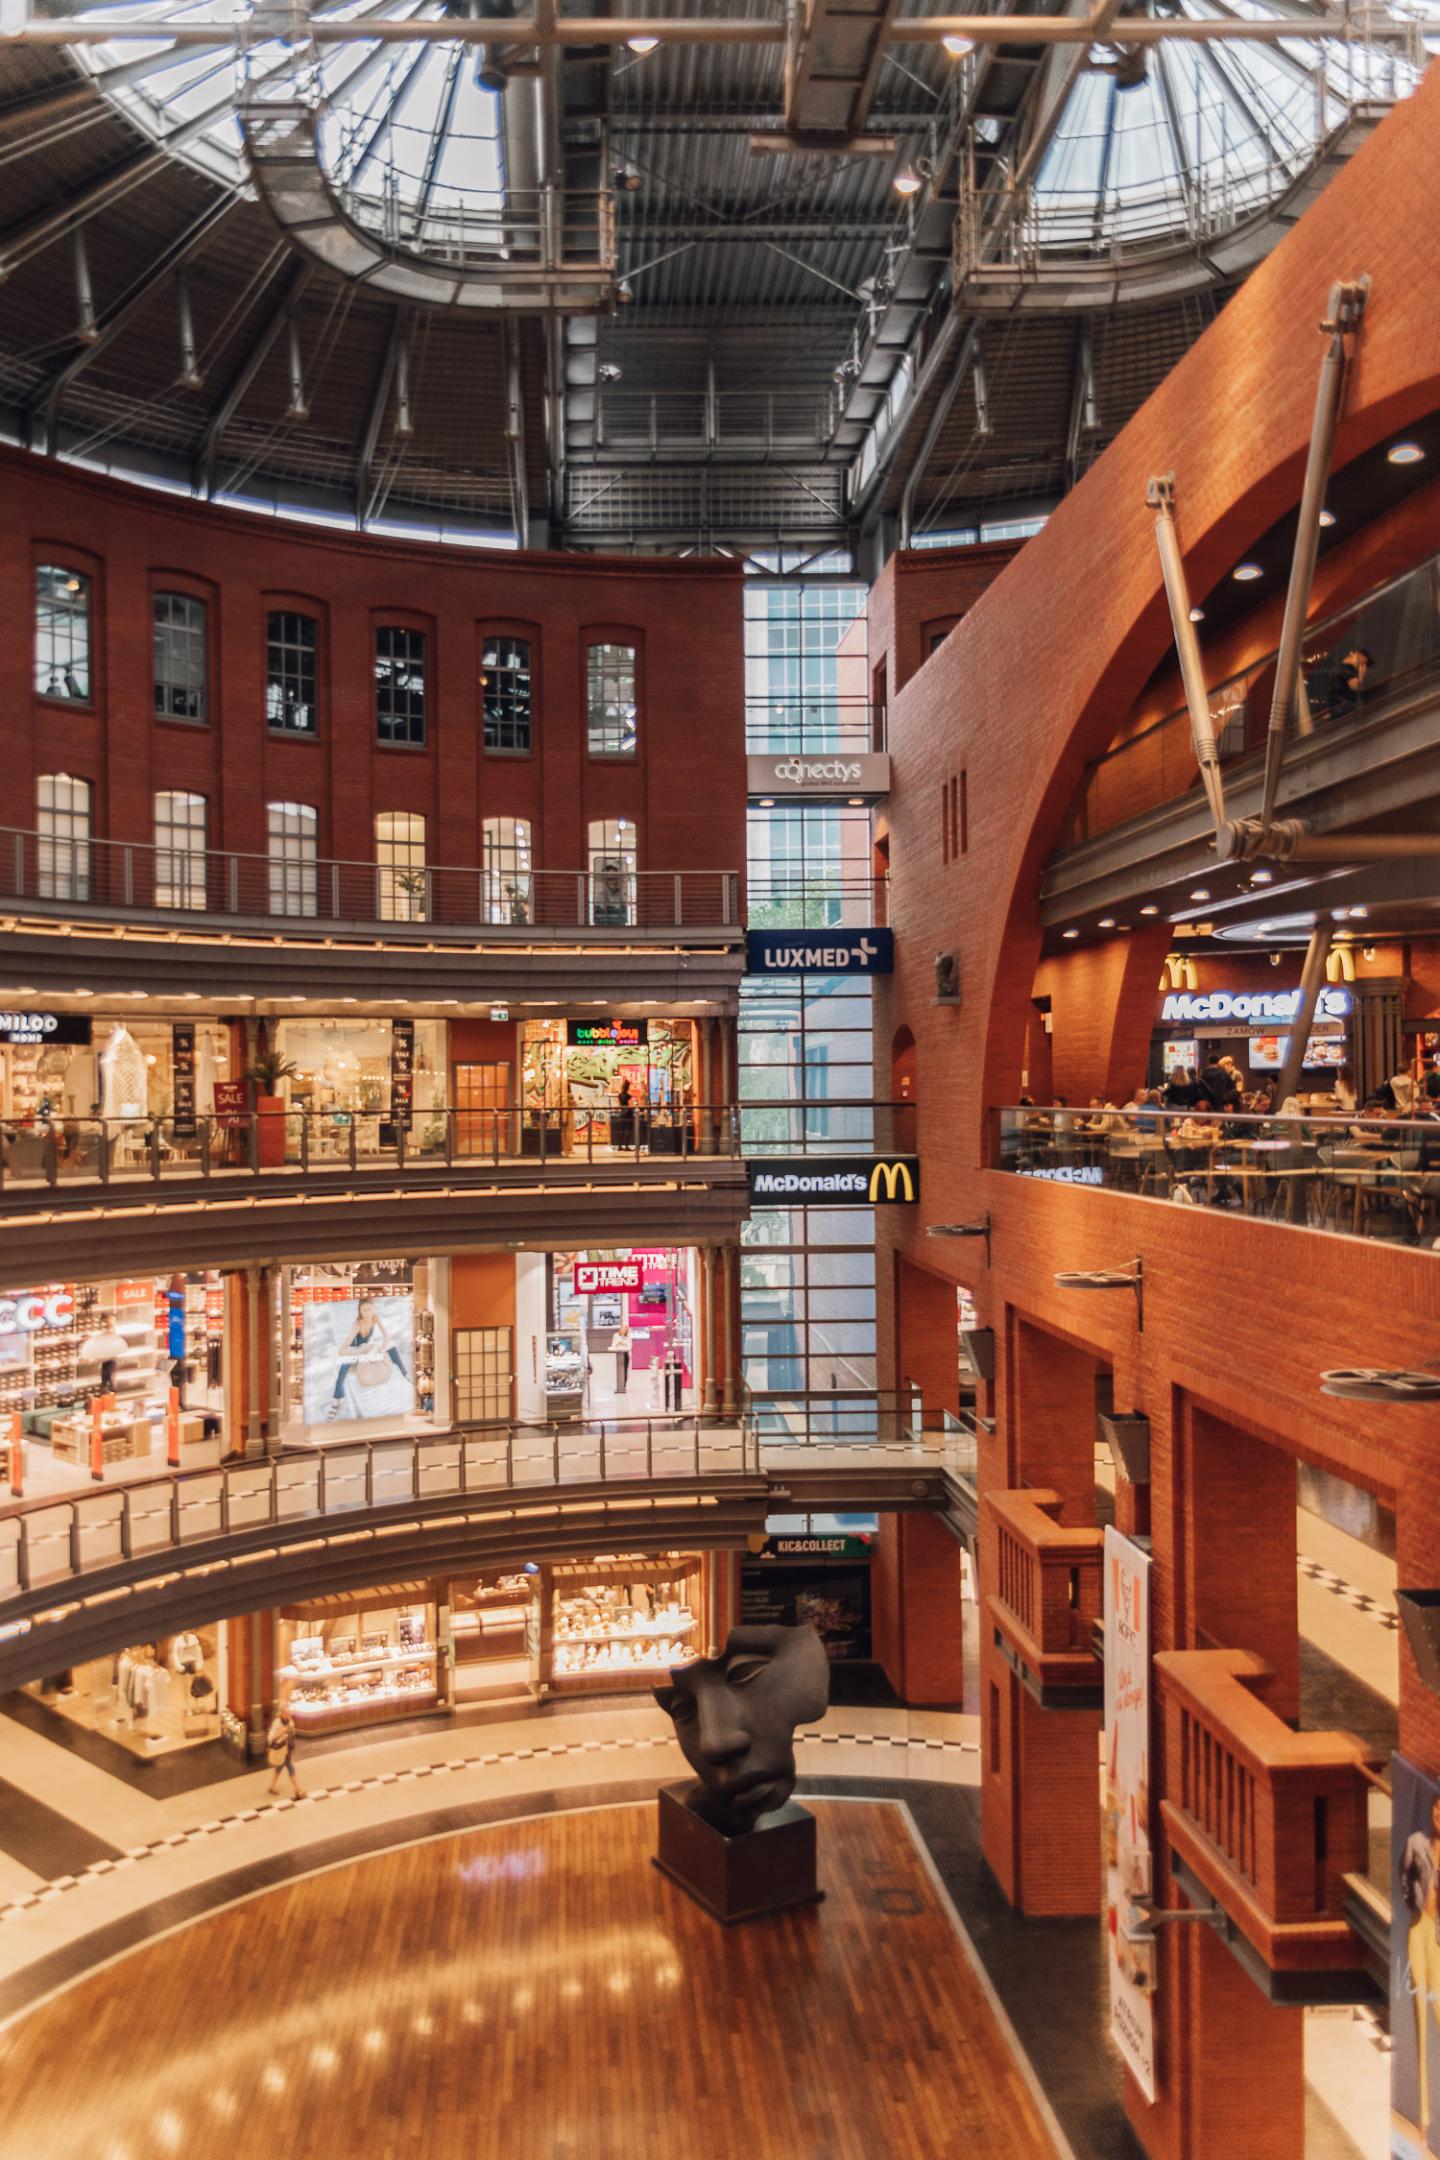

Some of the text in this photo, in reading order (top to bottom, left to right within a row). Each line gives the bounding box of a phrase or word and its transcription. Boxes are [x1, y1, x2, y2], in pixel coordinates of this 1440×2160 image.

[764, 948, 850, 967] LUXMED
[218, 1092, 243, 1104] SALE
[754, 1173, 868, 1192] McDonald's
[598, 1266, 639, 1279] TIME
[599, 1277, 639, 1287] TREND
[123, 1288, 147, 1299] SALE
